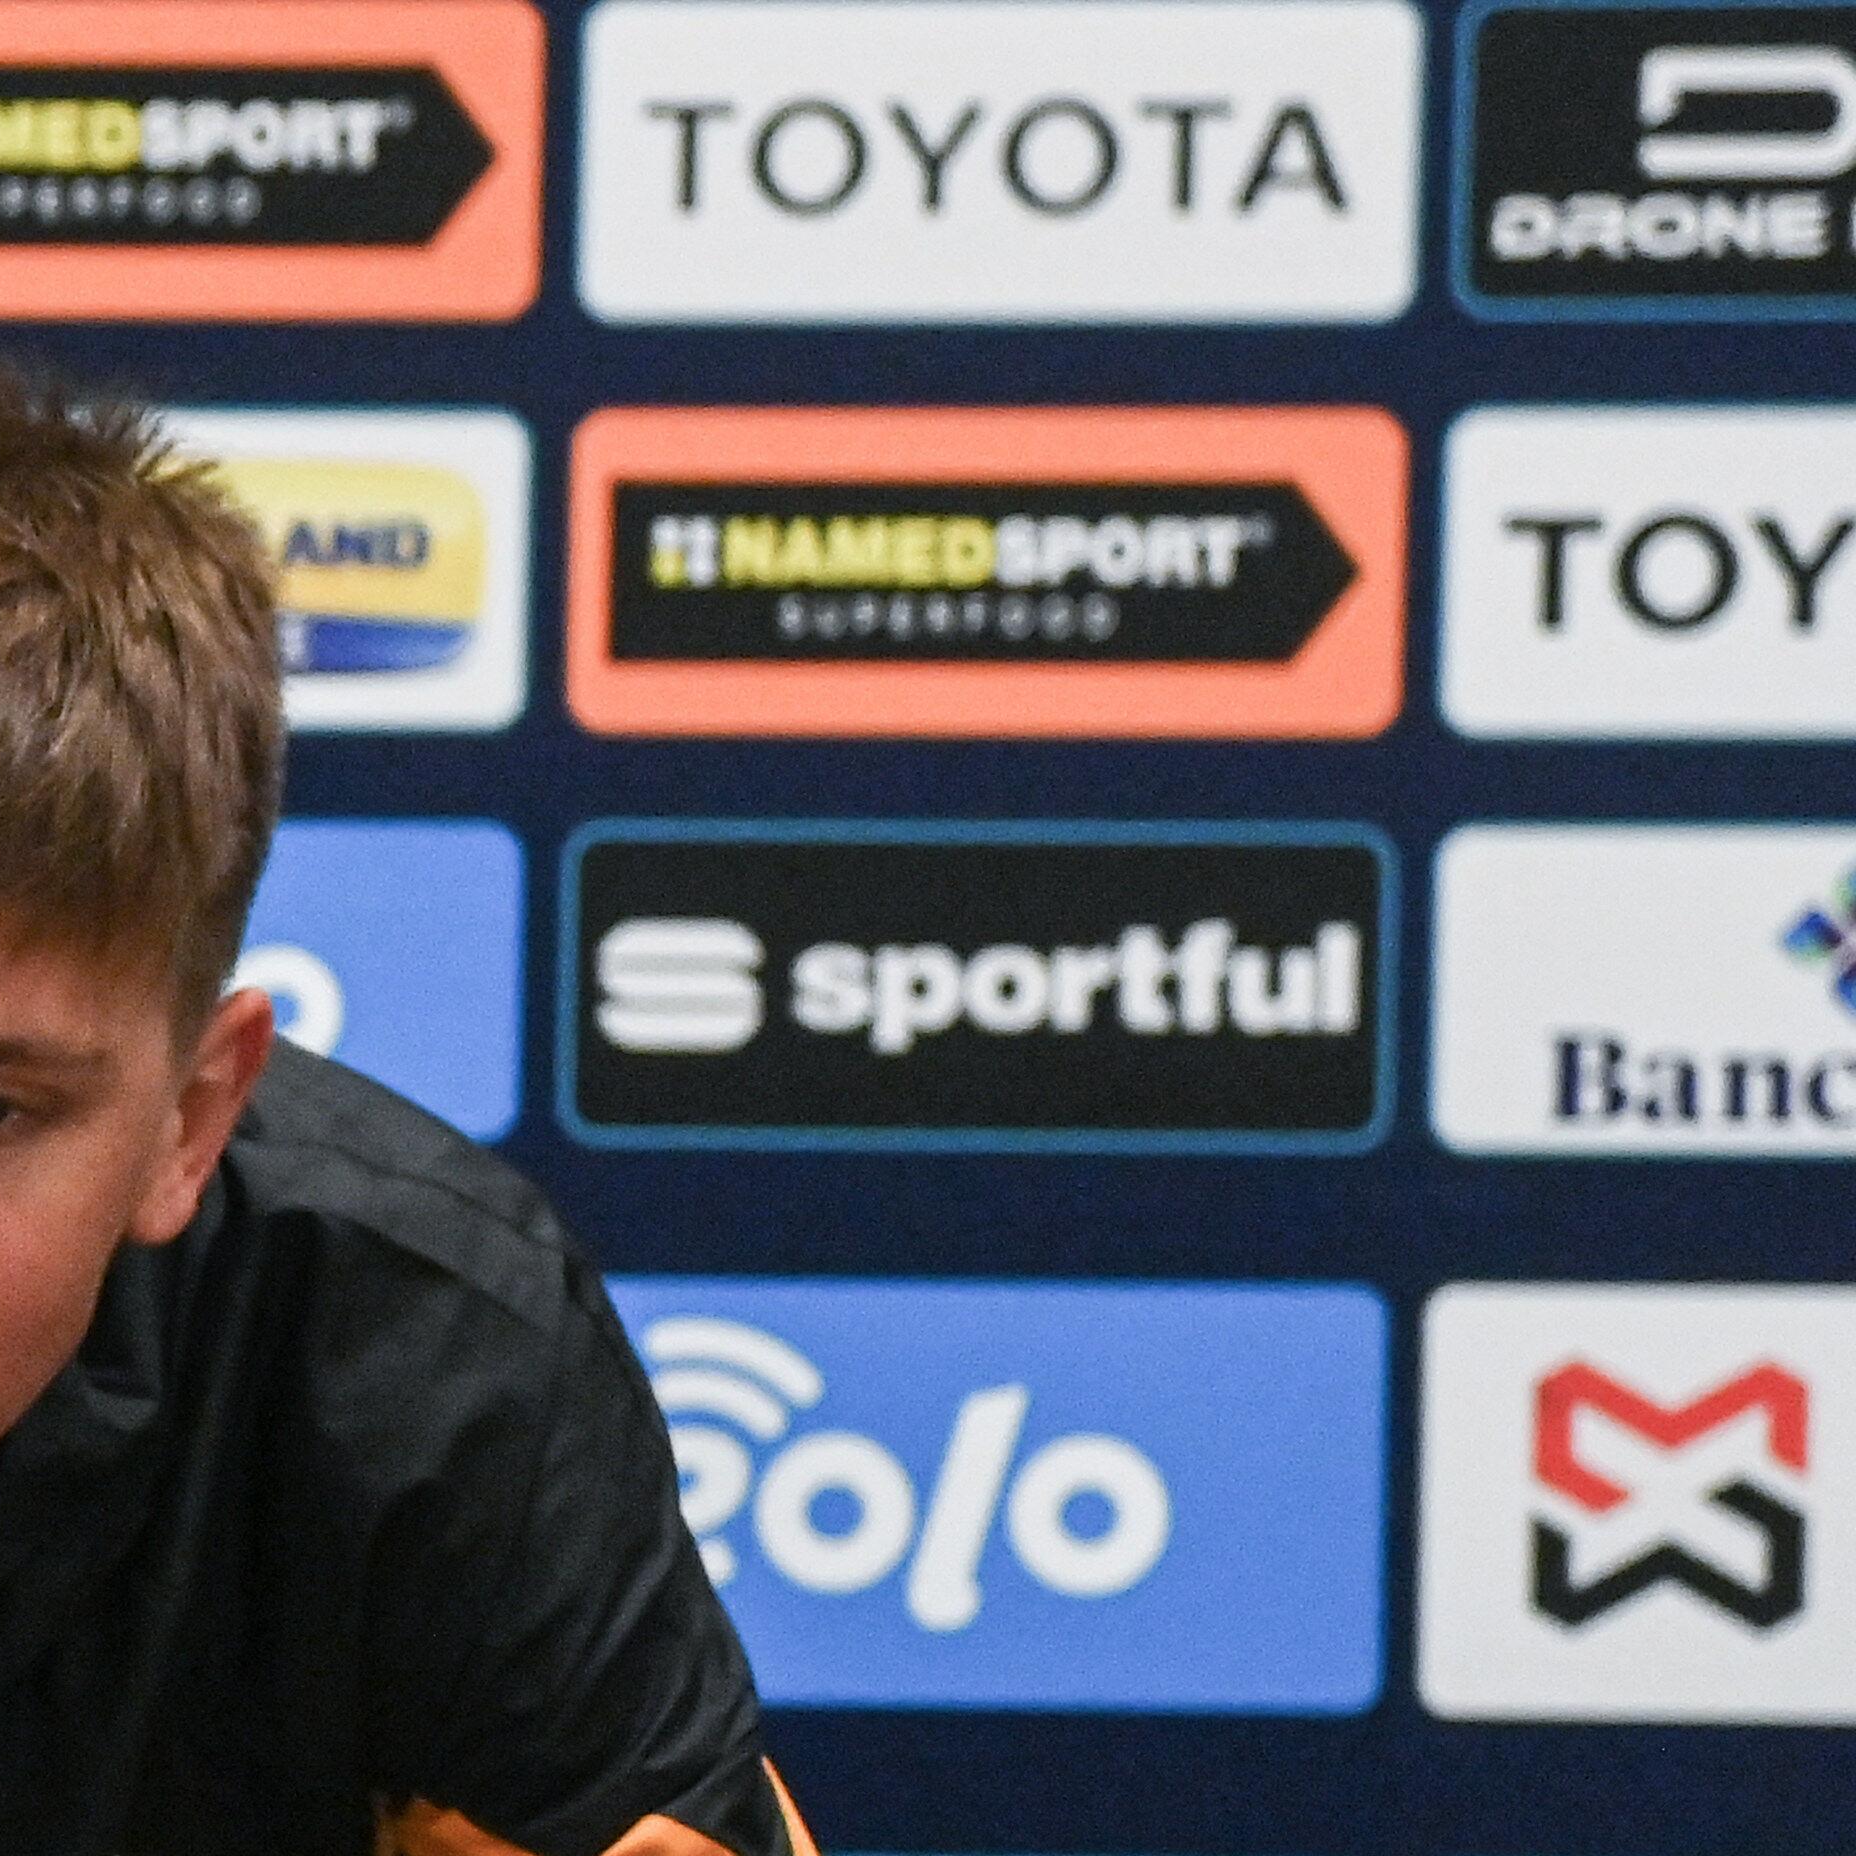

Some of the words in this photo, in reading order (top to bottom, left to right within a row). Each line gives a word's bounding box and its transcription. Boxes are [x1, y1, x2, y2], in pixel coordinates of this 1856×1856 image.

[651, 98, 1348, 218] TOYOTA
[1491, 193, 1829, 260] DRONE
[792, 919, 1360, 1053] sportful
